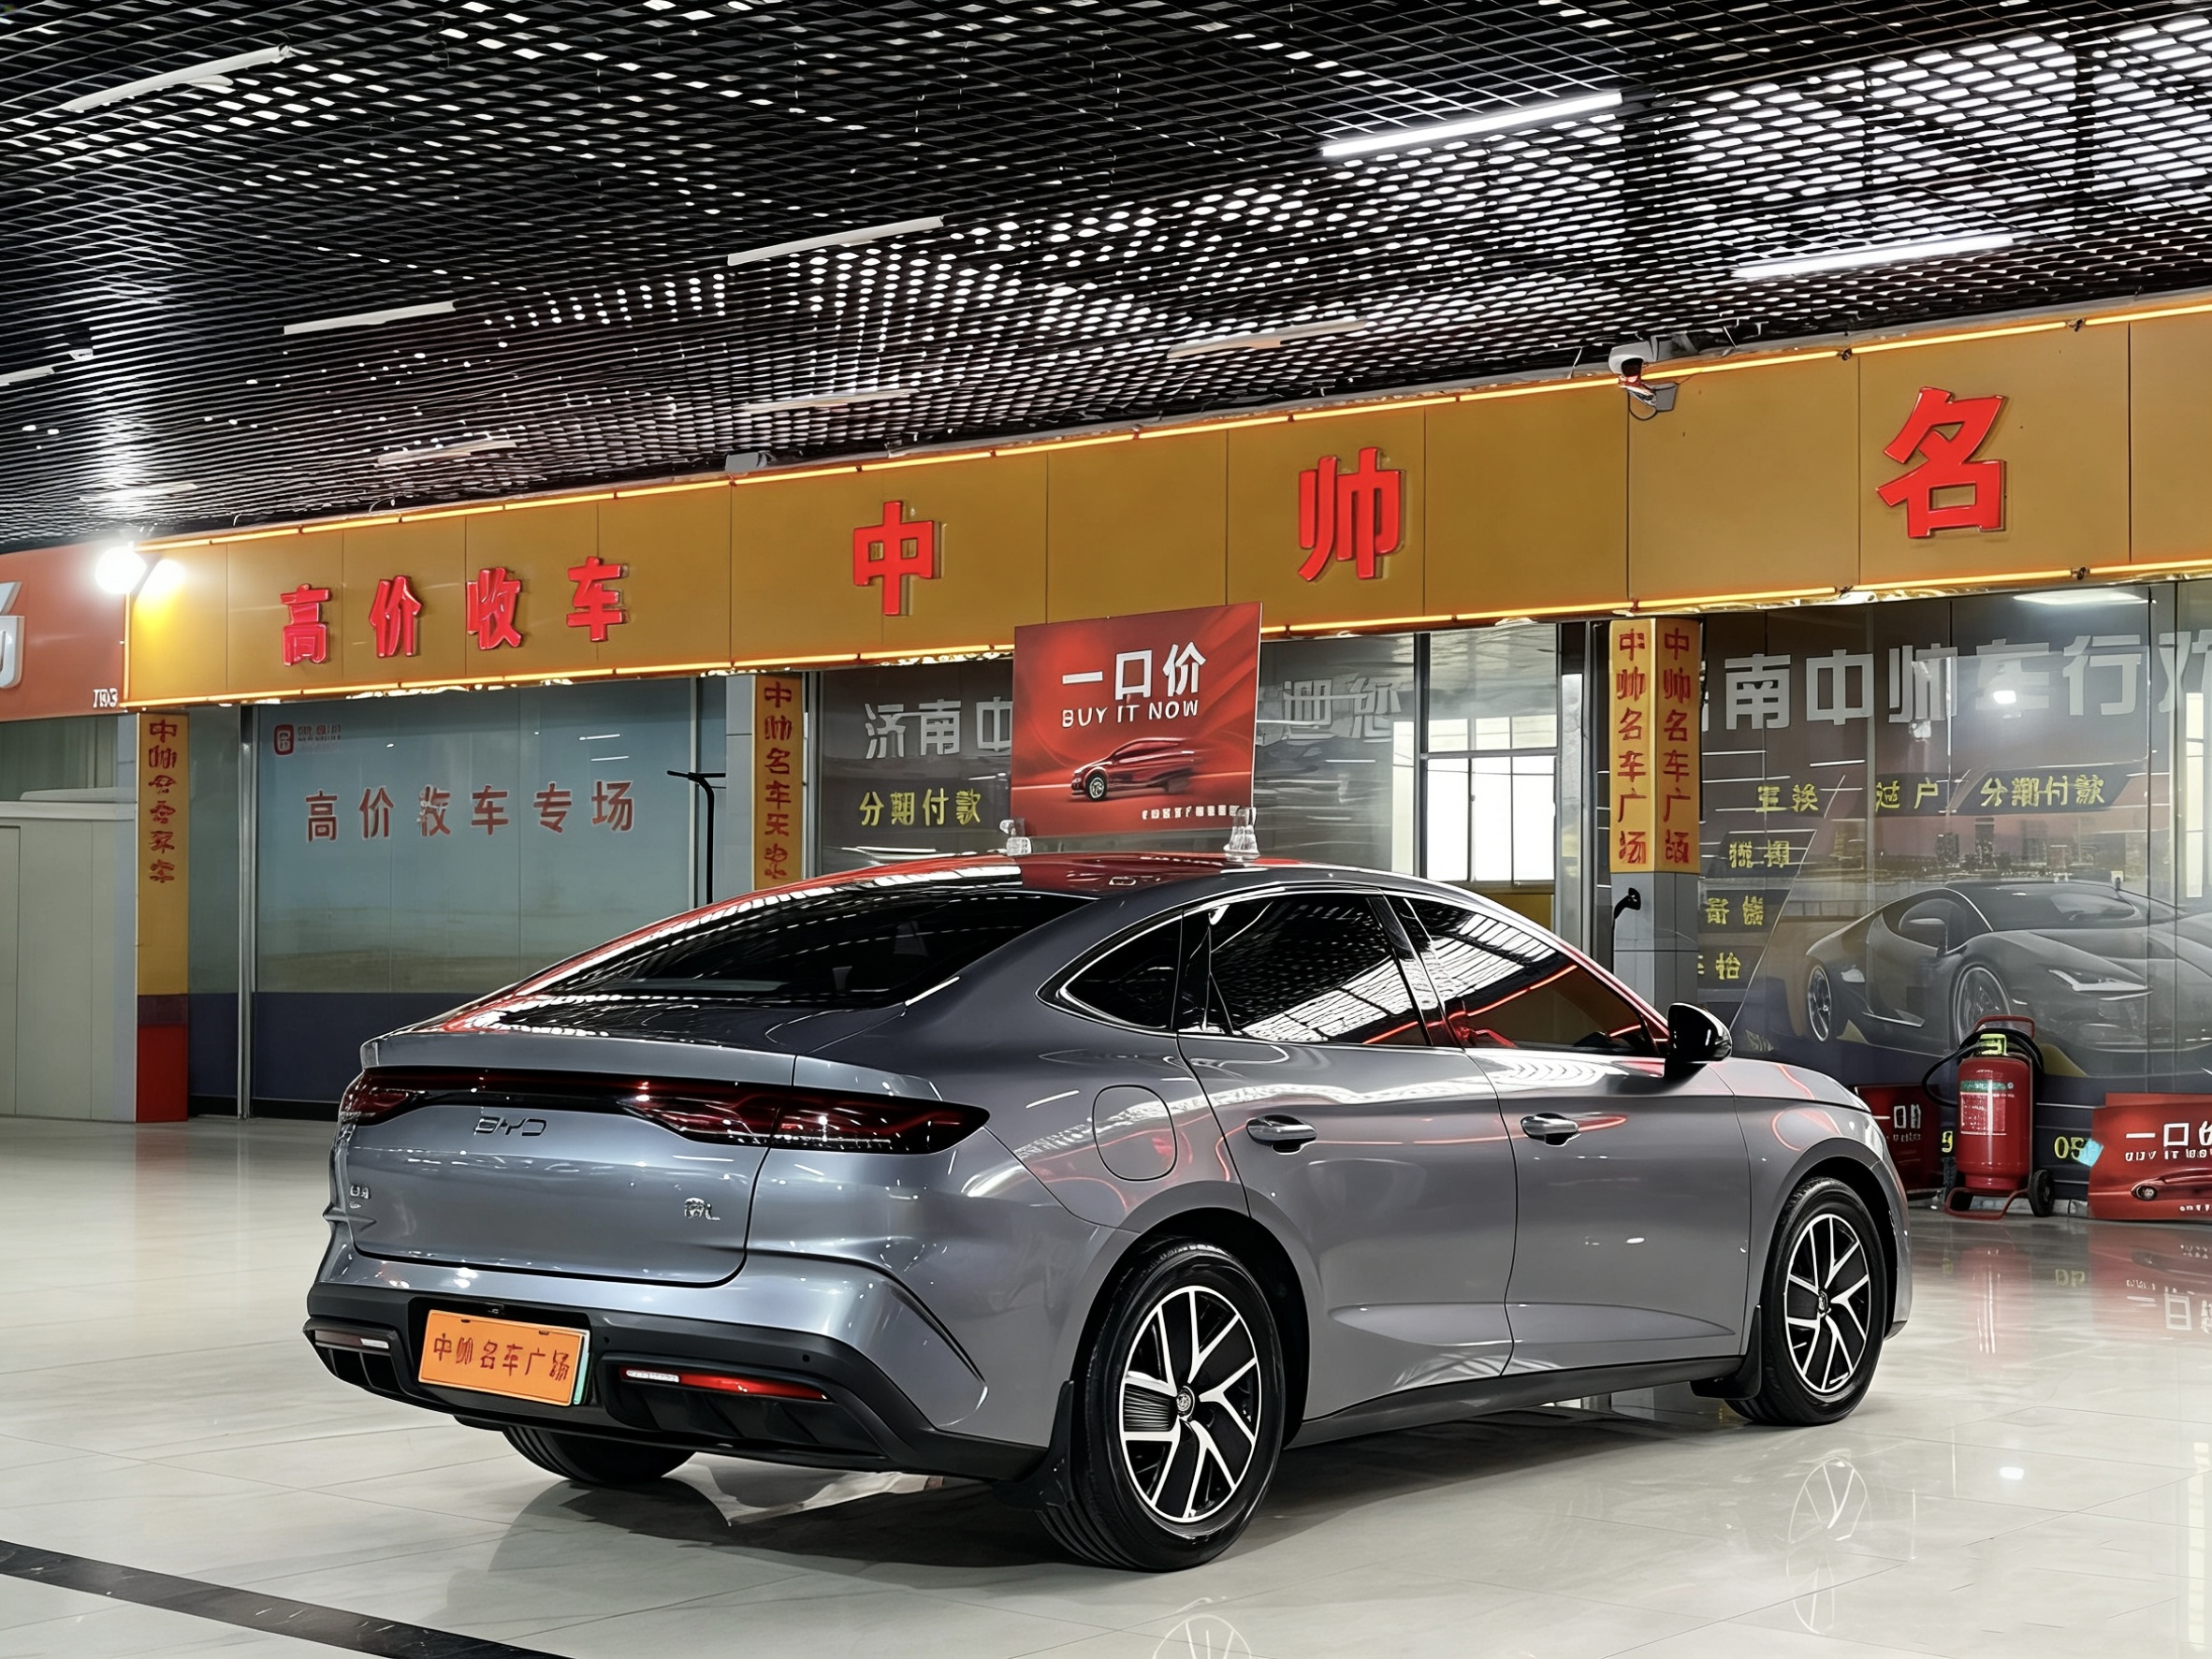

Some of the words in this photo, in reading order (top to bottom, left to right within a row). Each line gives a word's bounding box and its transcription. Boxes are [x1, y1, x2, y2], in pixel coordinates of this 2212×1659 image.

[281, 556, 629, 667] 高价收车
[1062, 641, 1207, 701] 一口价
[864, 696, 1014, 760] 济南中
[1061, 707, 1108, 728] BUY
[1117, 704, 1140, 723] IT
[1148, 699, 1199, 720] NOW
[304, 780, 634, 842] 高价收车专场
[859, 788, 982, 826] 分期付款
[474, 1116, 547, 1137] BYD
